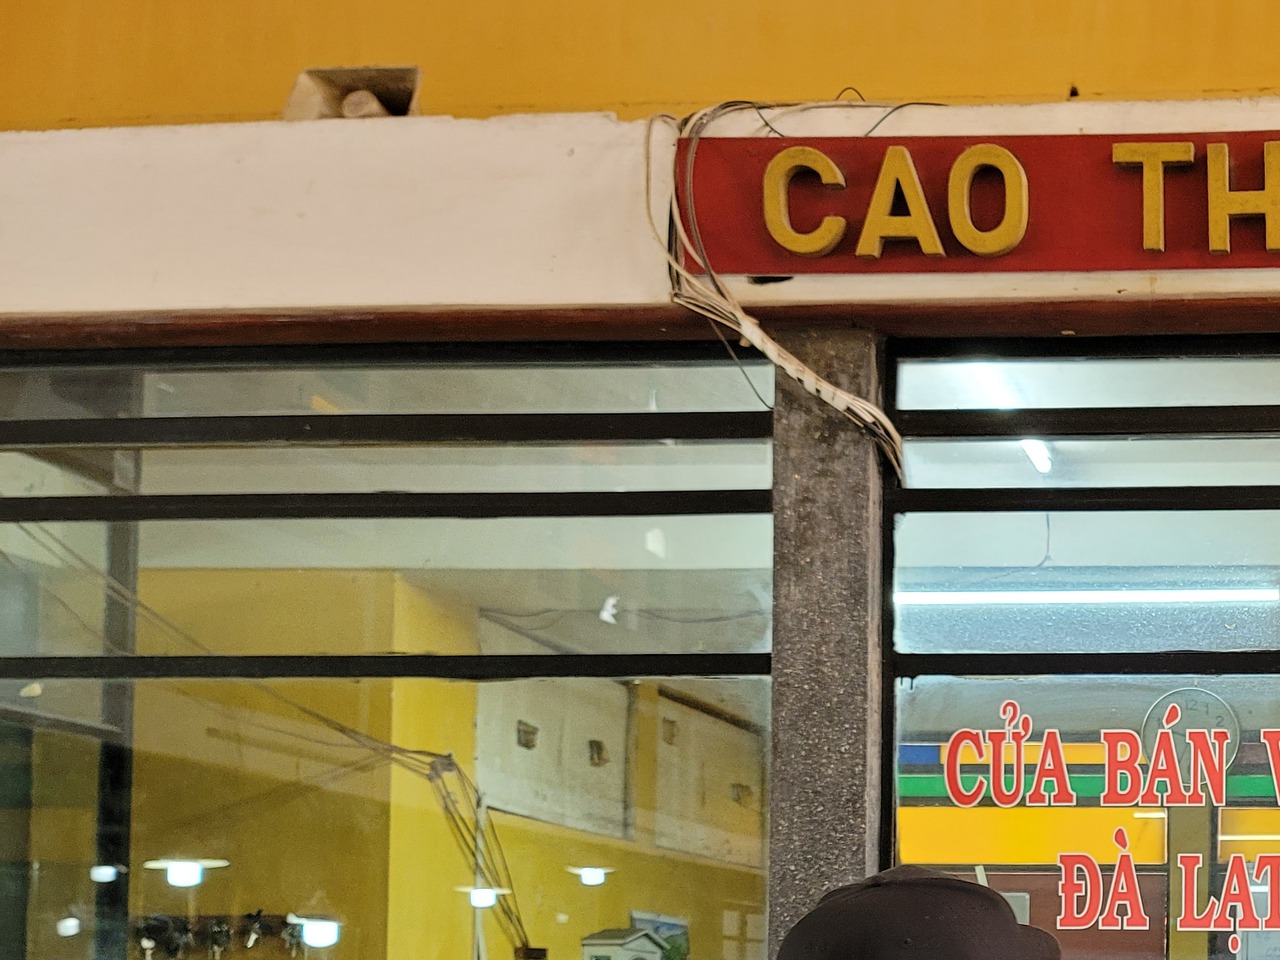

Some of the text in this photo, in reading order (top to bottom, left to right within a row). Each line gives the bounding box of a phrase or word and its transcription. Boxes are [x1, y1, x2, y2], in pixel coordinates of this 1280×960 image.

[763, 143, 1029, 259] CAO
[944, 700, 1077, 807] CỬA
[1101, 703, 1231, 807] BÁN
[1057, 827, 1150, 931] ĐÀ
